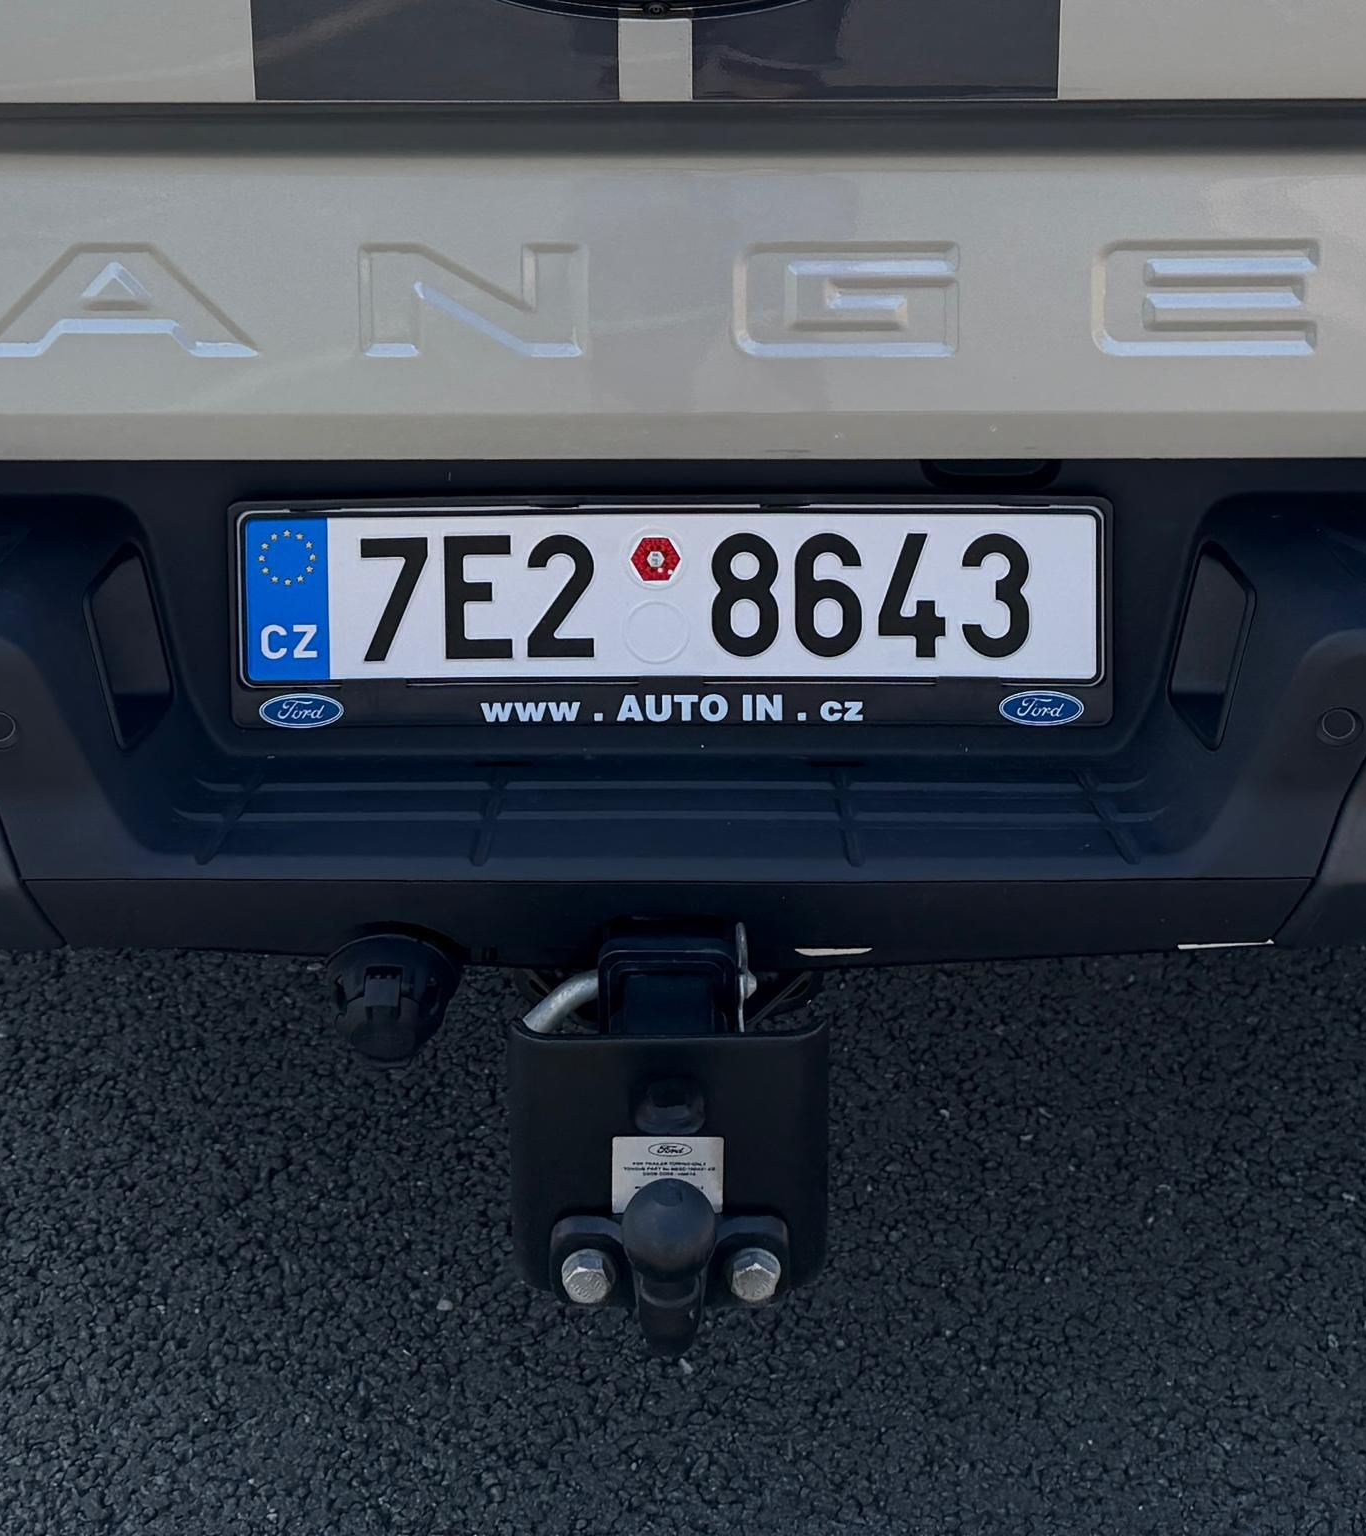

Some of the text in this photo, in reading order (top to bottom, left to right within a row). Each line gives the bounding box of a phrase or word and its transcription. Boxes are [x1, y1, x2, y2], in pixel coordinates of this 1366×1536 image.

[360, 532, 1030, 661] 7E2 8643
[260, 624, 318, 660] CZ
[277, 699, 326, 721] Ford
[480, 701, 581, 723] www
[616, 694, 729, 723] AUTO
[742, 693, 783, 722] IN
[819, 700, 864, 722] cz
[1016, 697, 1065, 718] Ford
[656, 1144, 685, 1154] Ford
